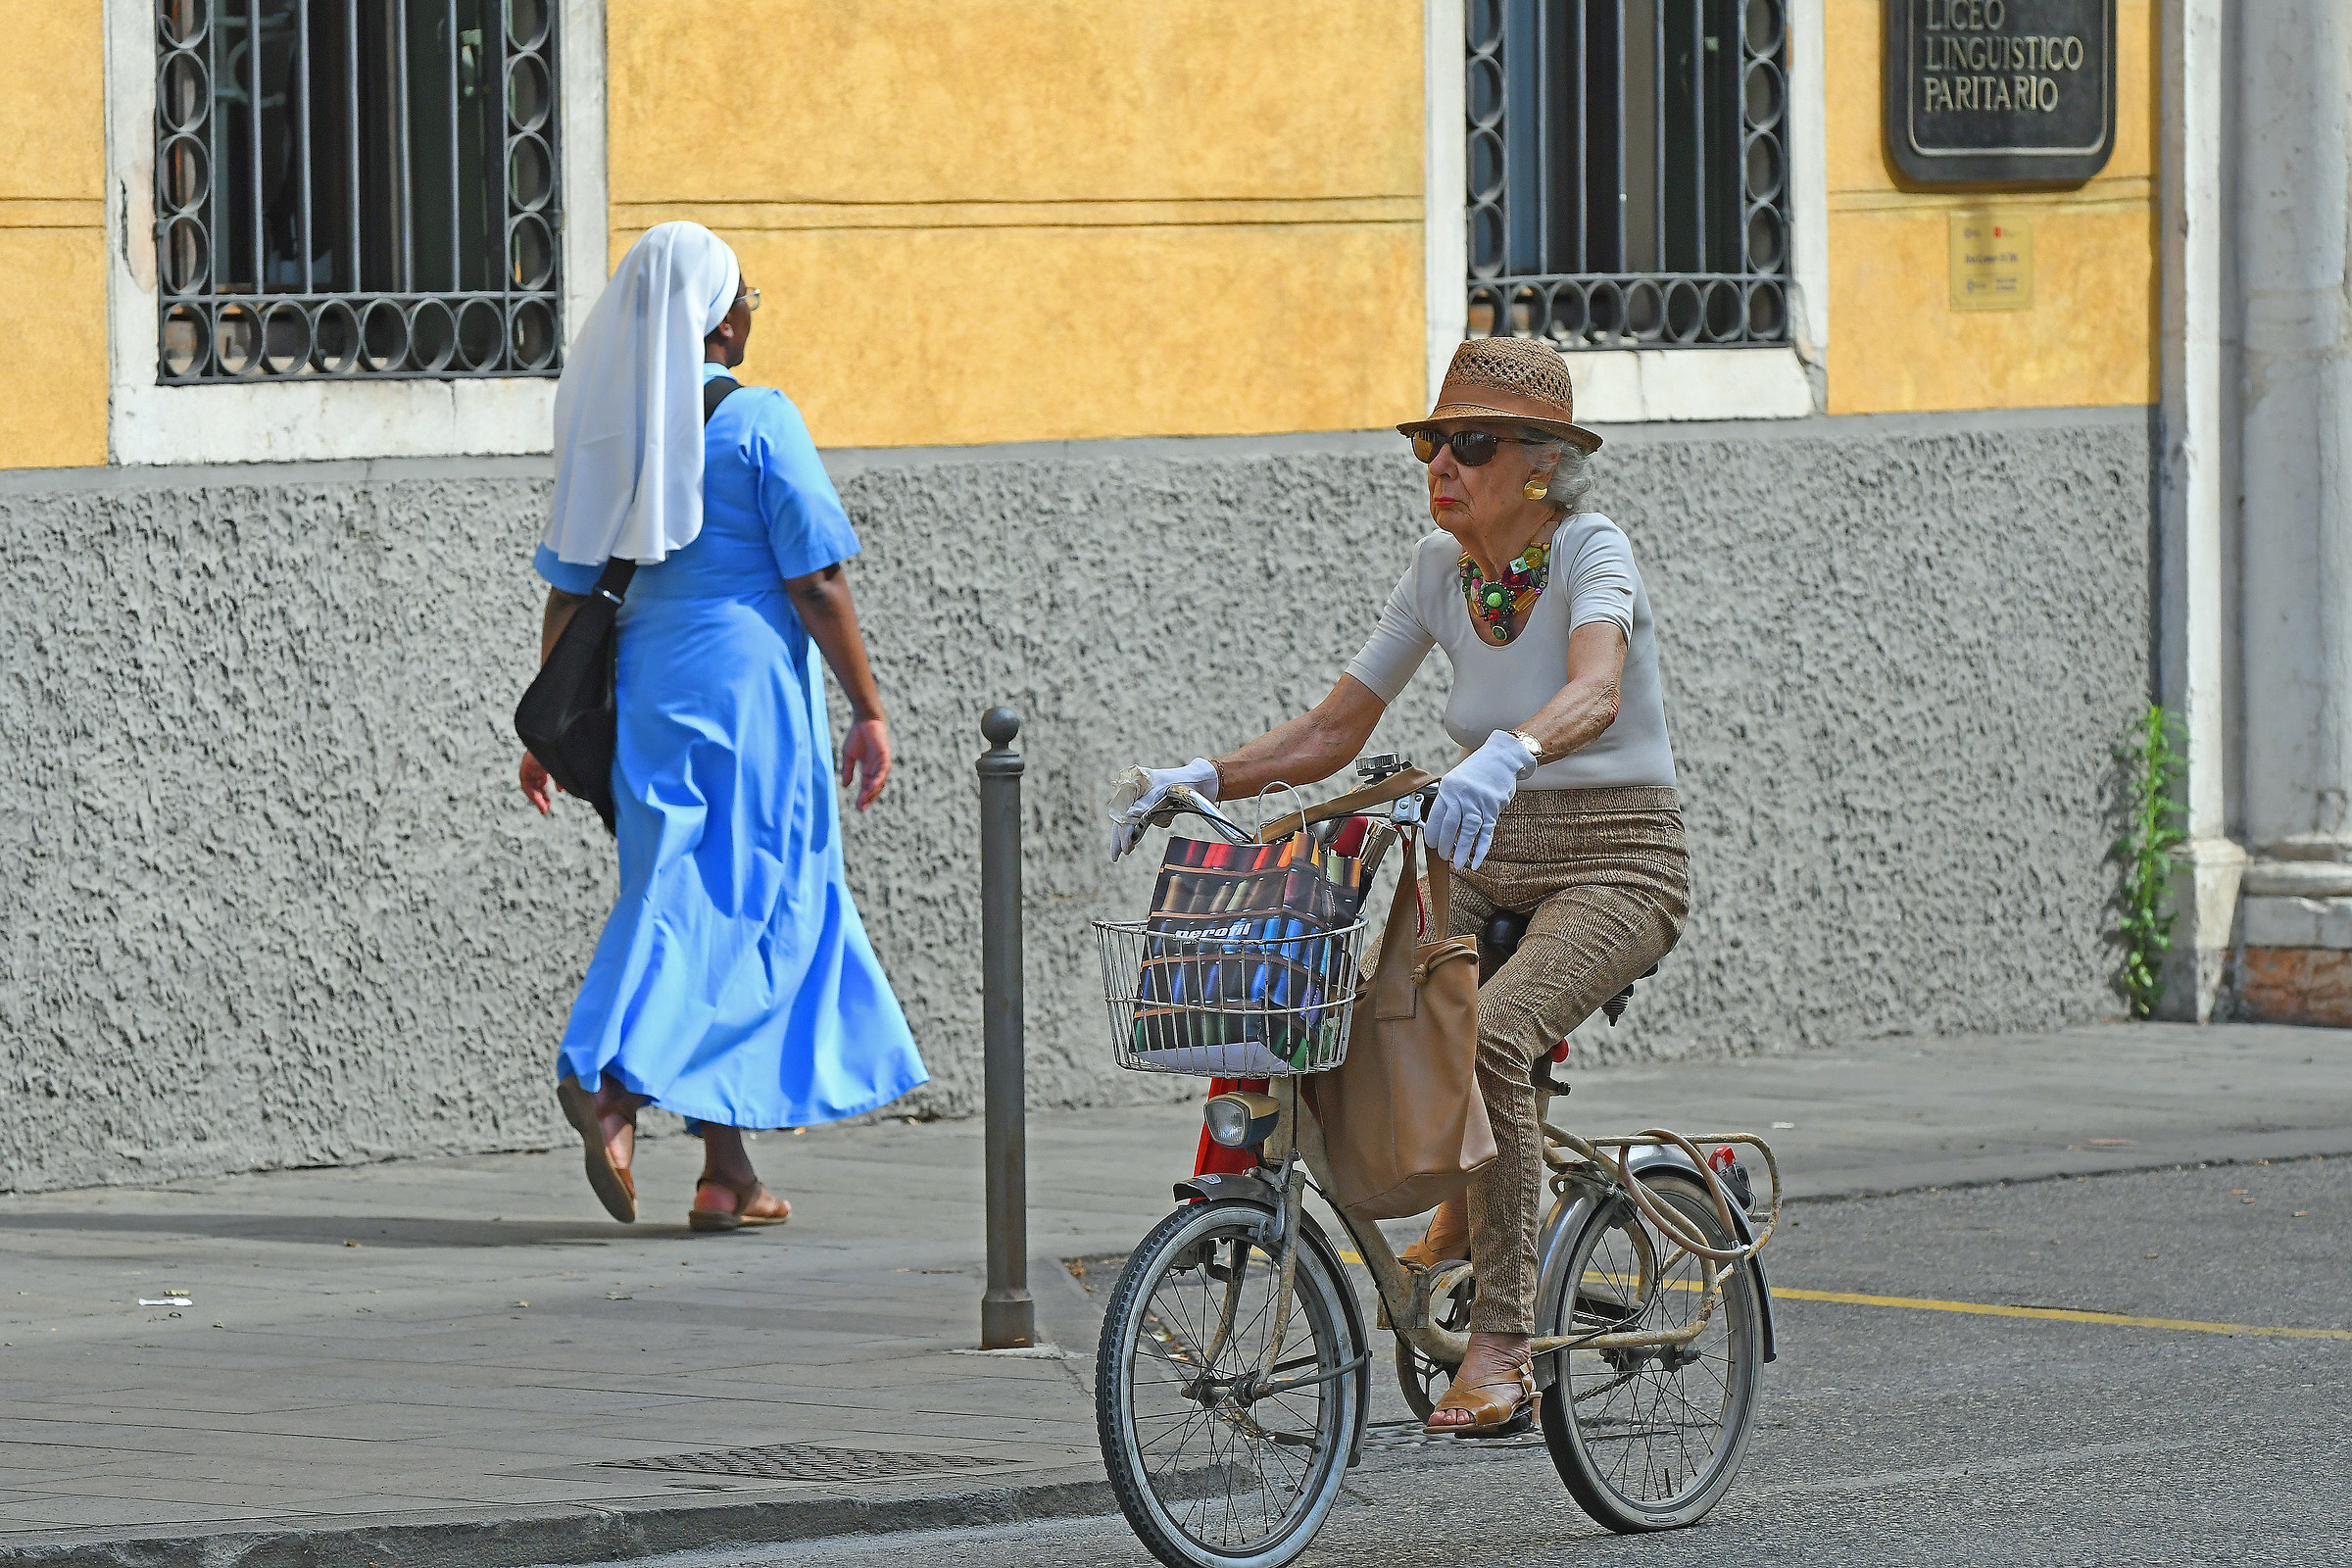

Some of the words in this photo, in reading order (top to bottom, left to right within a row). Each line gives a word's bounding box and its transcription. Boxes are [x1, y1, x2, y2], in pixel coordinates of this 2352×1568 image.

[1926, 0, 2005, 30] LICEO
[1925, 35, 2084, 72] LINGUISTICO
[1923, 74, 2059, 112] PARITARIO
